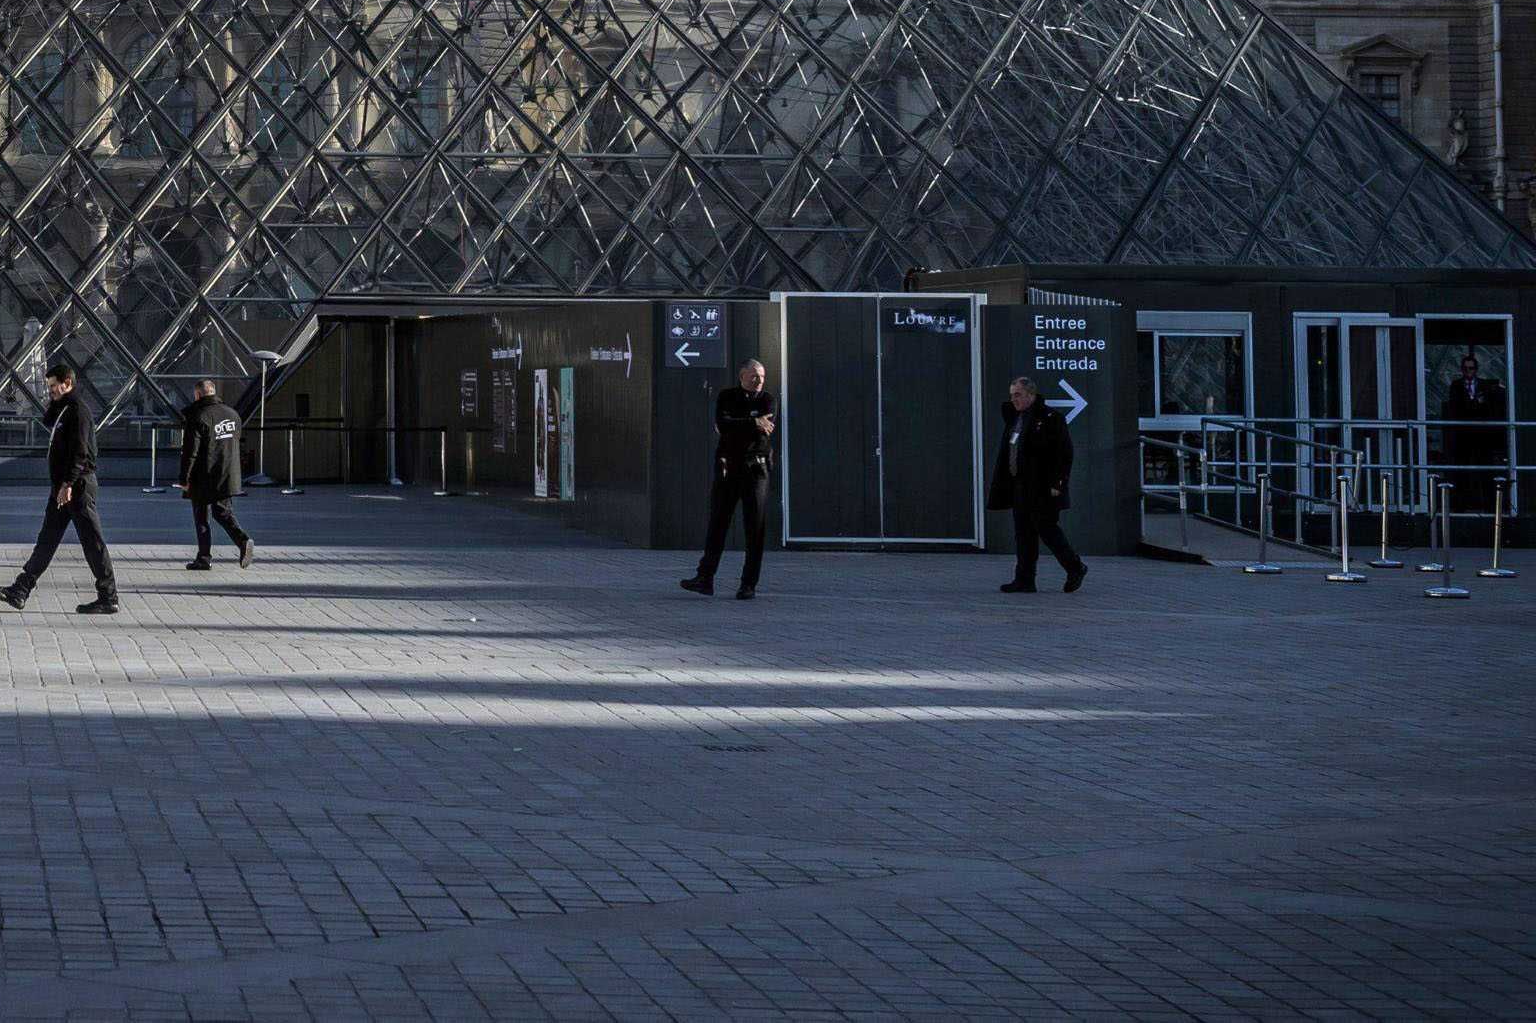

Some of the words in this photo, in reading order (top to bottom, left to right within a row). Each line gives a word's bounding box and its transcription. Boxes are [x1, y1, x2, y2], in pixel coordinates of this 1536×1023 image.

[1035, 315, 1087, 330] Entree
[1035, 335, 1106, 350] Entrance
[1035, 356, 1098, 370] Entrada
